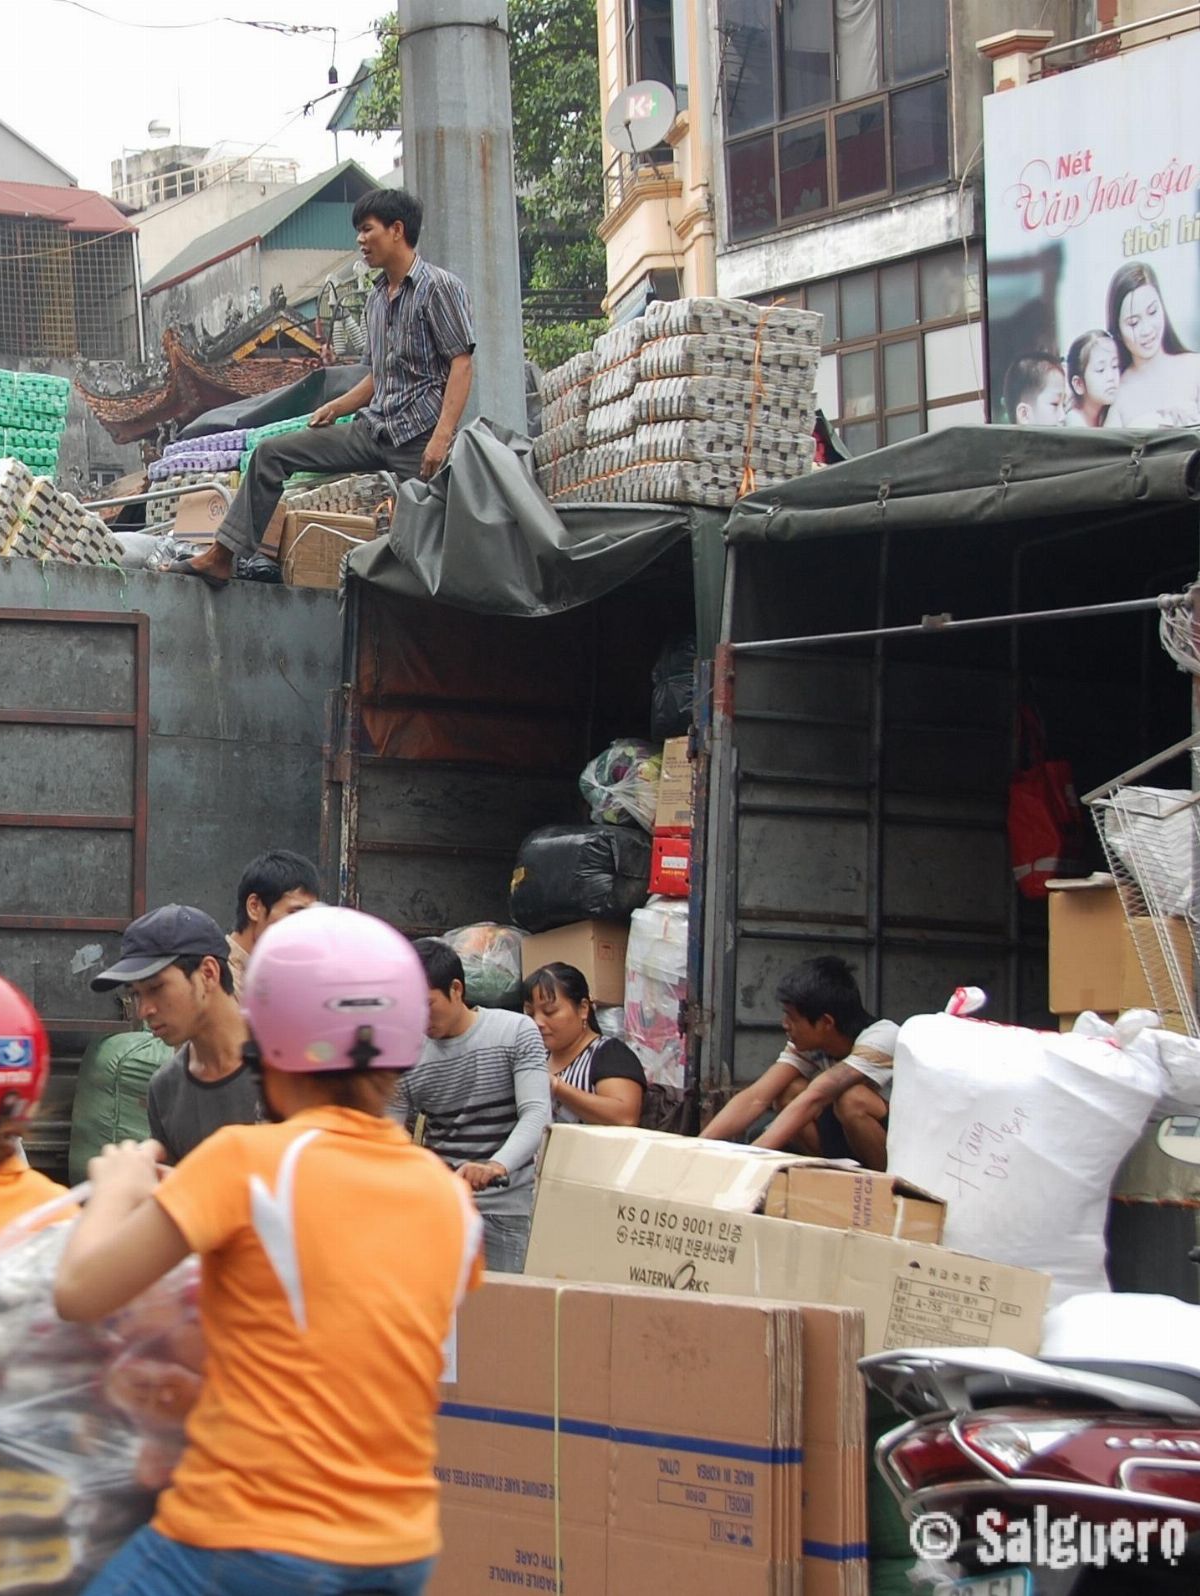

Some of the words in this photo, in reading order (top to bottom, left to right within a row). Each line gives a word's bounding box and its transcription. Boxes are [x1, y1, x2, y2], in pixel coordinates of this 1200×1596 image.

[1057, 149, 1093, 180] Nét
[1086, 171, 1138, 215] hóa
[1137, 157, 1193, 221] gia
[1122, 218, 1171, 258] thời
[852, 1175, 863, 1227] FRAGILE
[863, 1198, 873, 1227] WITH
[617, 1204, 636, 1222] KS
[640, 1208, 650, 1225] Q
[654, 1211, 678, 1230] ISO
[682, 1216, 713, 1236] 9001
[718, 1222, 743, 1244] 인증
[629, 1259, 710, 1293] WATERWORKS
[696, 1463, 721, 1481] KOREA
[734, 1468, 755, 1487] MADE
[727, 1494, 752, 1514] MODEL
[515, 1550, 539, 1567] CARE
[489, 1566, 524, 1585] HANDLE
